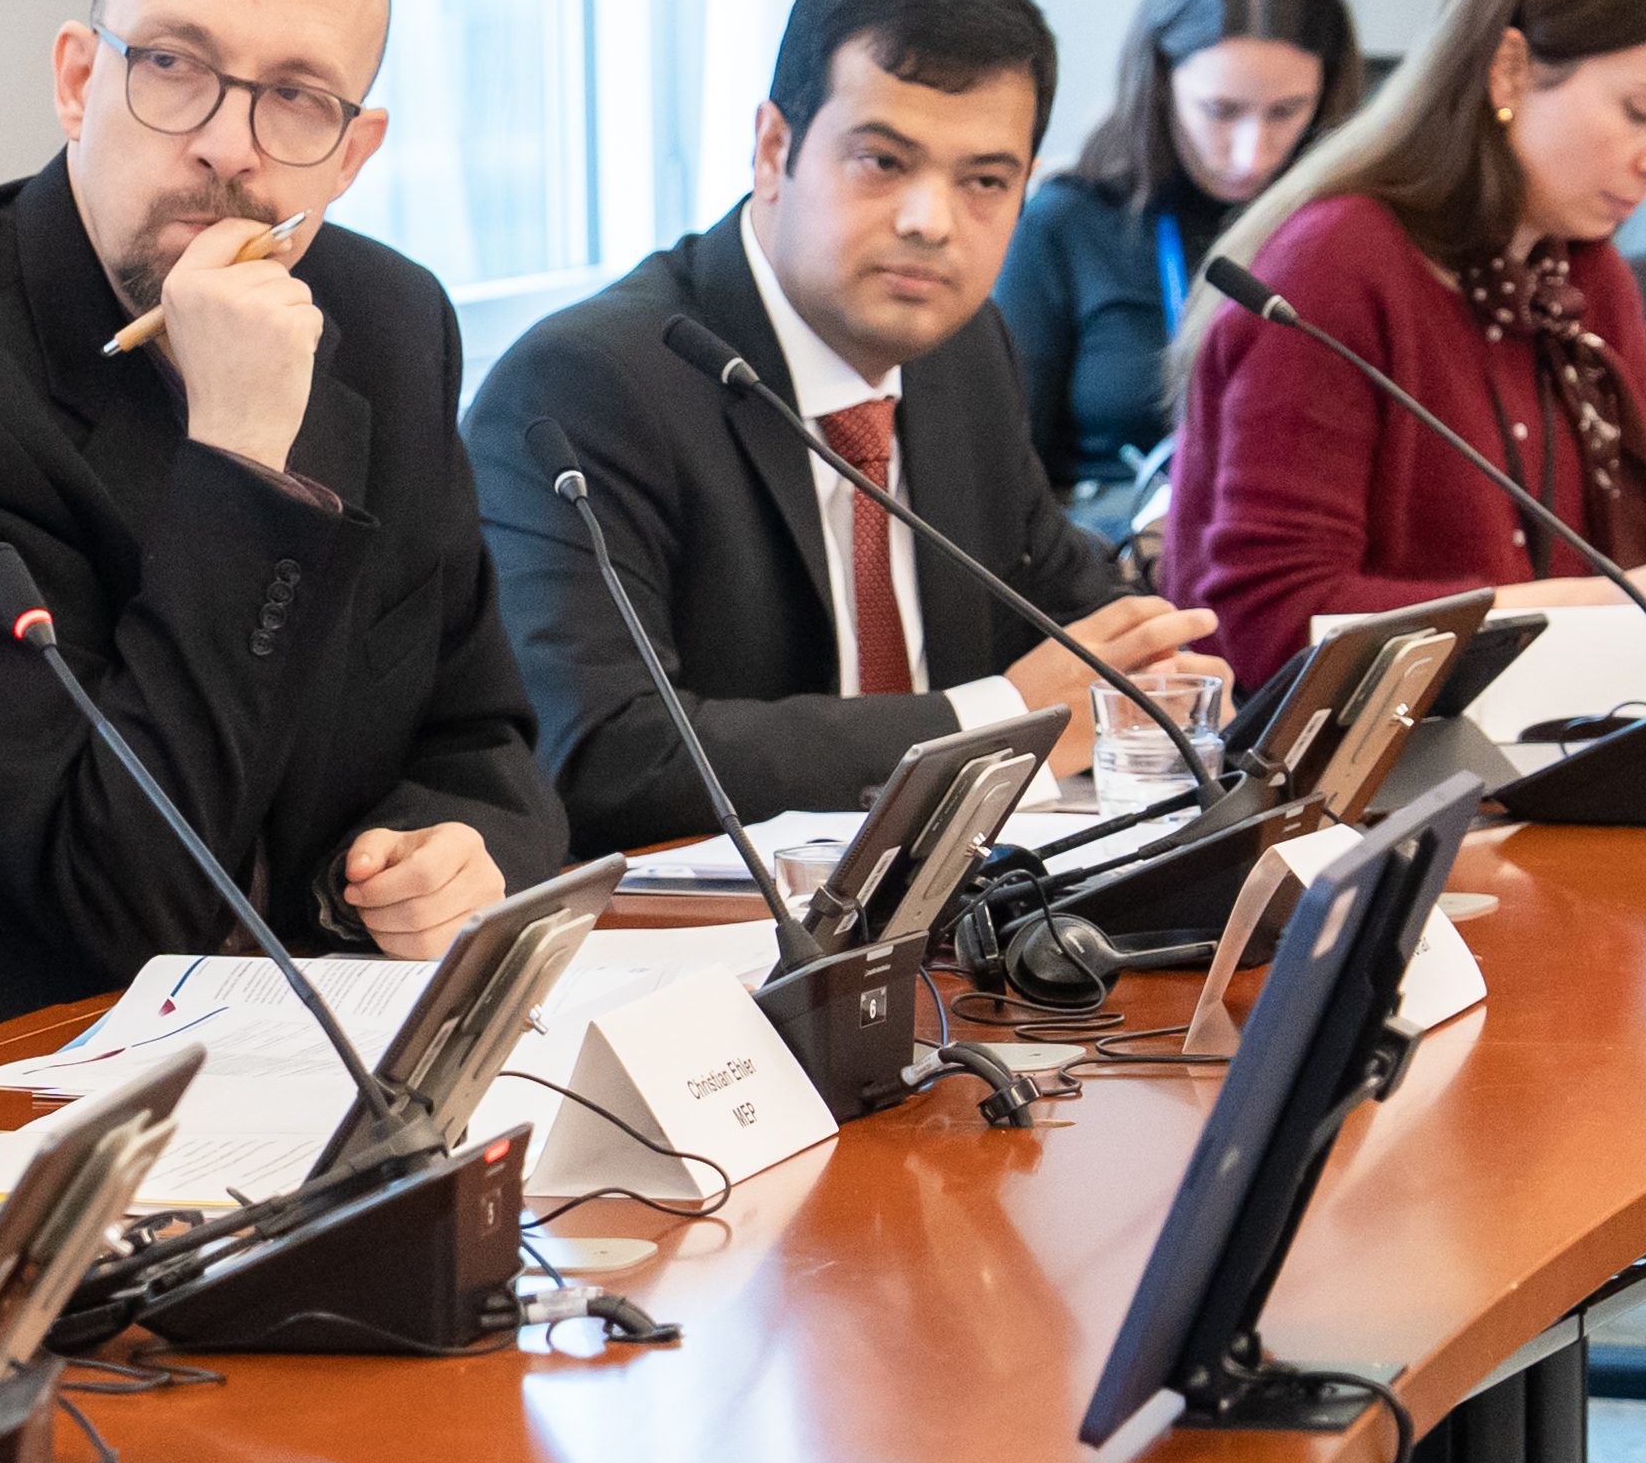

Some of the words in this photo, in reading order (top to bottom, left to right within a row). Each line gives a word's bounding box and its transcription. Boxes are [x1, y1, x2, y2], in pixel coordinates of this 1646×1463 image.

[870, 999, 877, 1019] 6
[687, 1069, 734, 1100] Christian
[726, 1057, 757, 1081] Ehler
[732, 1102, 757, 1128] MEP
